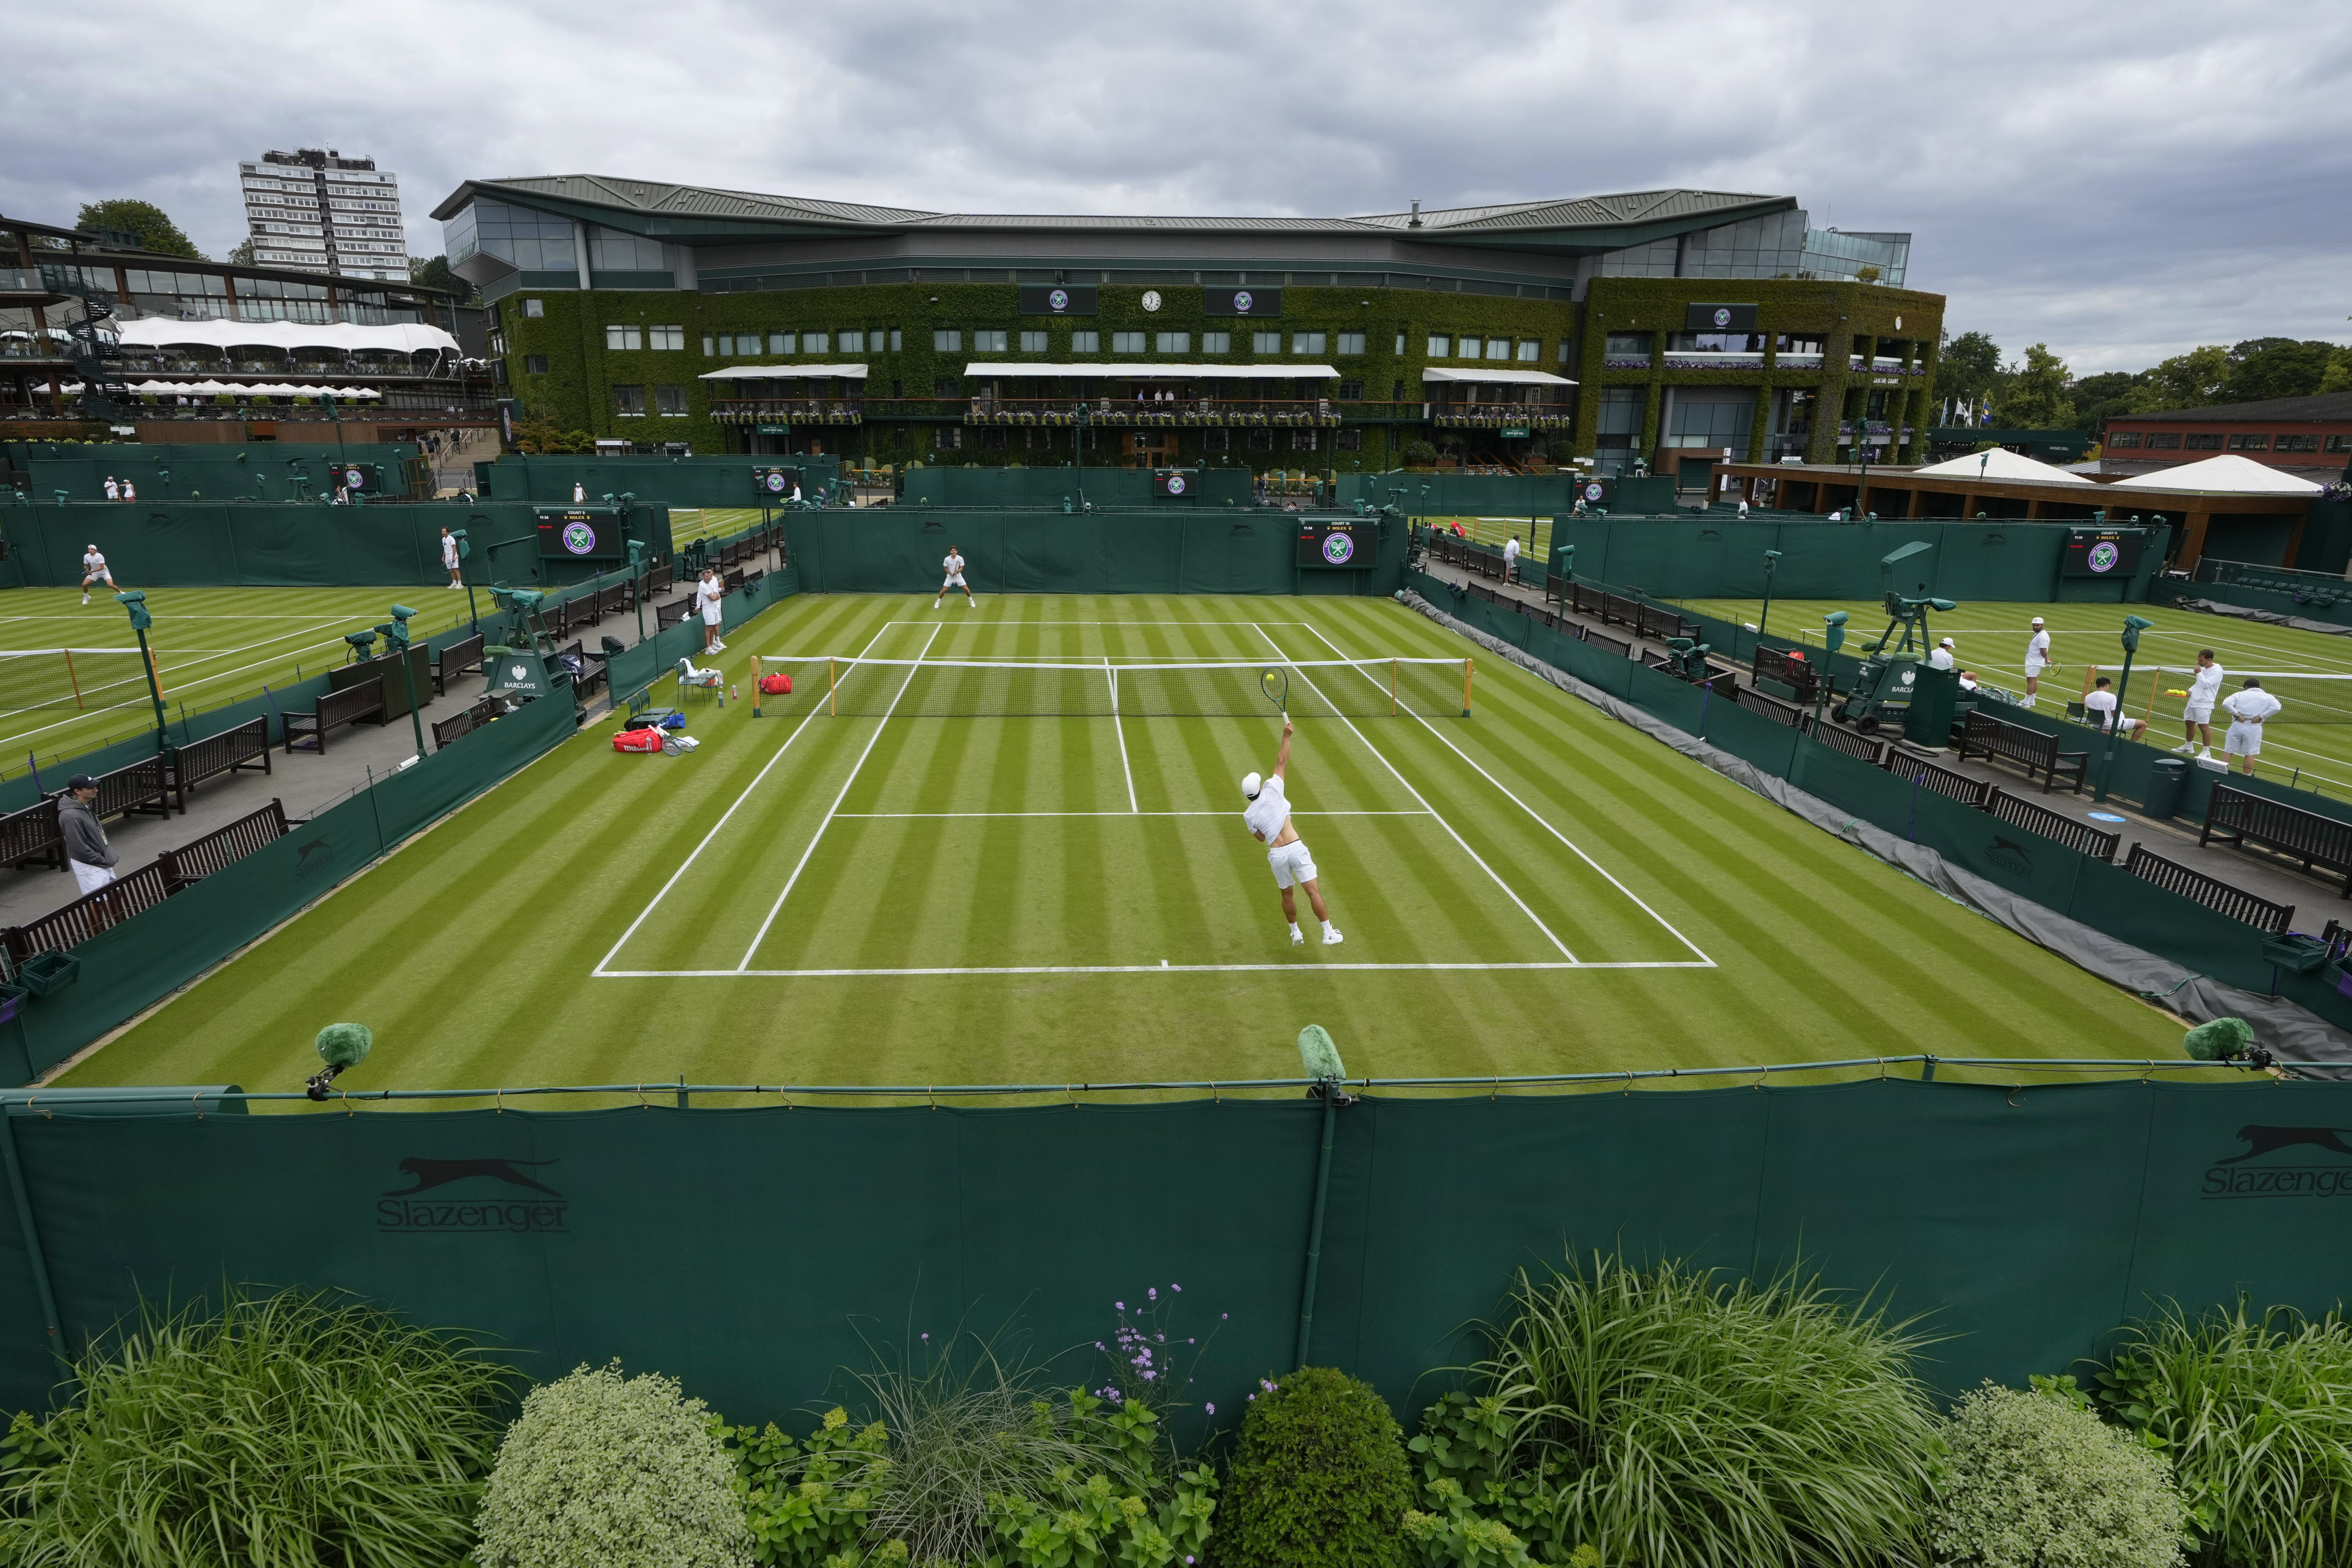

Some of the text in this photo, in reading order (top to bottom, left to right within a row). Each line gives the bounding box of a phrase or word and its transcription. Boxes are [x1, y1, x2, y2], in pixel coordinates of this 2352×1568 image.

[567, 524, 593, 537] CHAMPIONSHIPS
[1329, 534, 1351, 548] CHAMPIONSHIPS
[2096, 544, 2116, 556] CHAMPIONSHIPS
[295, 853, 333, 881] Slazenger
[1983, 848, 2034, 879] Slazenger
[376, 1200, 568, 1232] Slazenger
